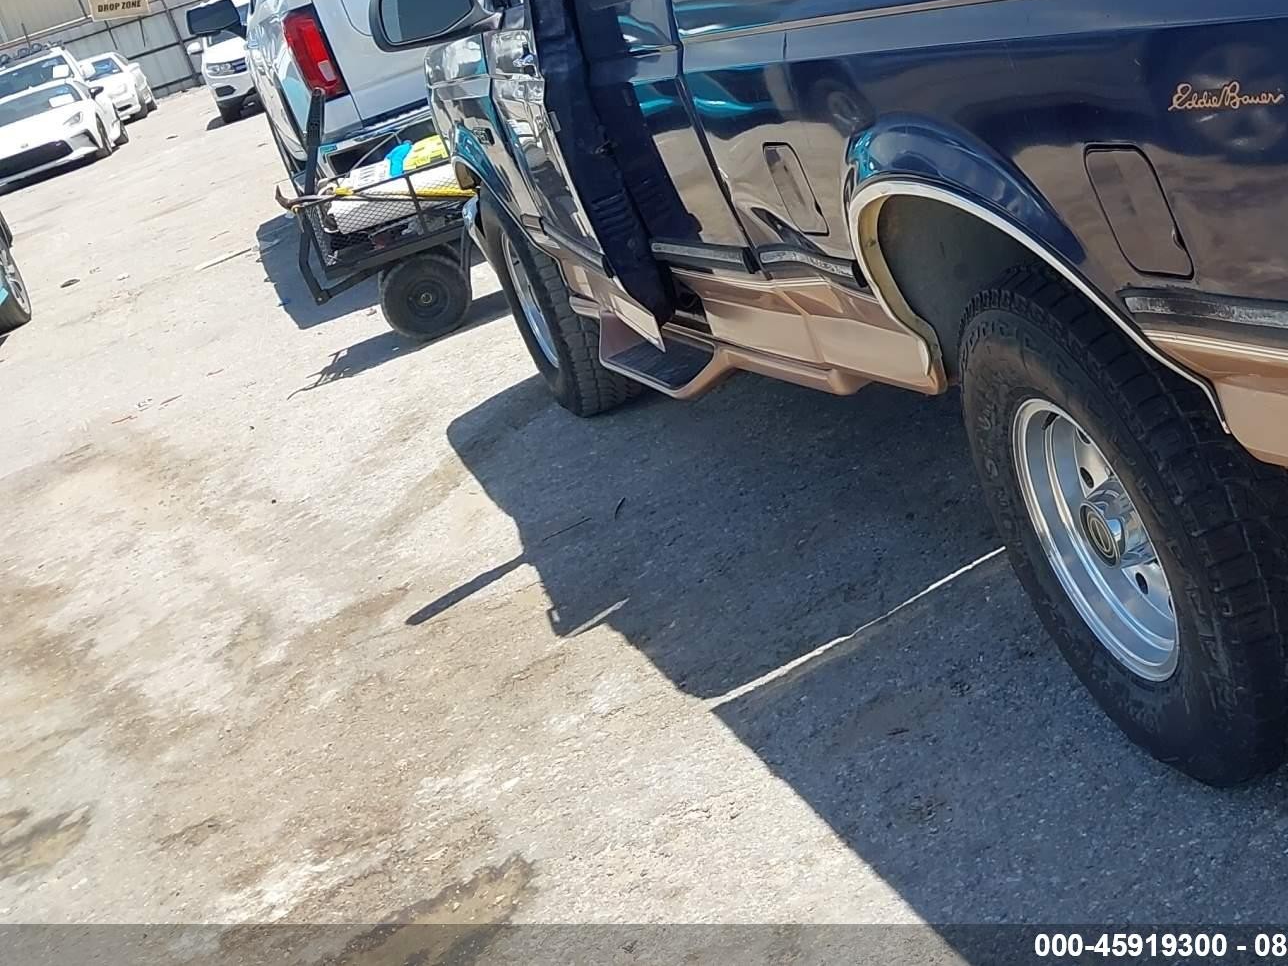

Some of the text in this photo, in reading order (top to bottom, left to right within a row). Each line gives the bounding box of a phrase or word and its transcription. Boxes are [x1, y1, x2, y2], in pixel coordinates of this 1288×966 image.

[97, 0, 142, 13] DROP ZONE
[1167, 81, 1285, 111] Eddie Bauer
